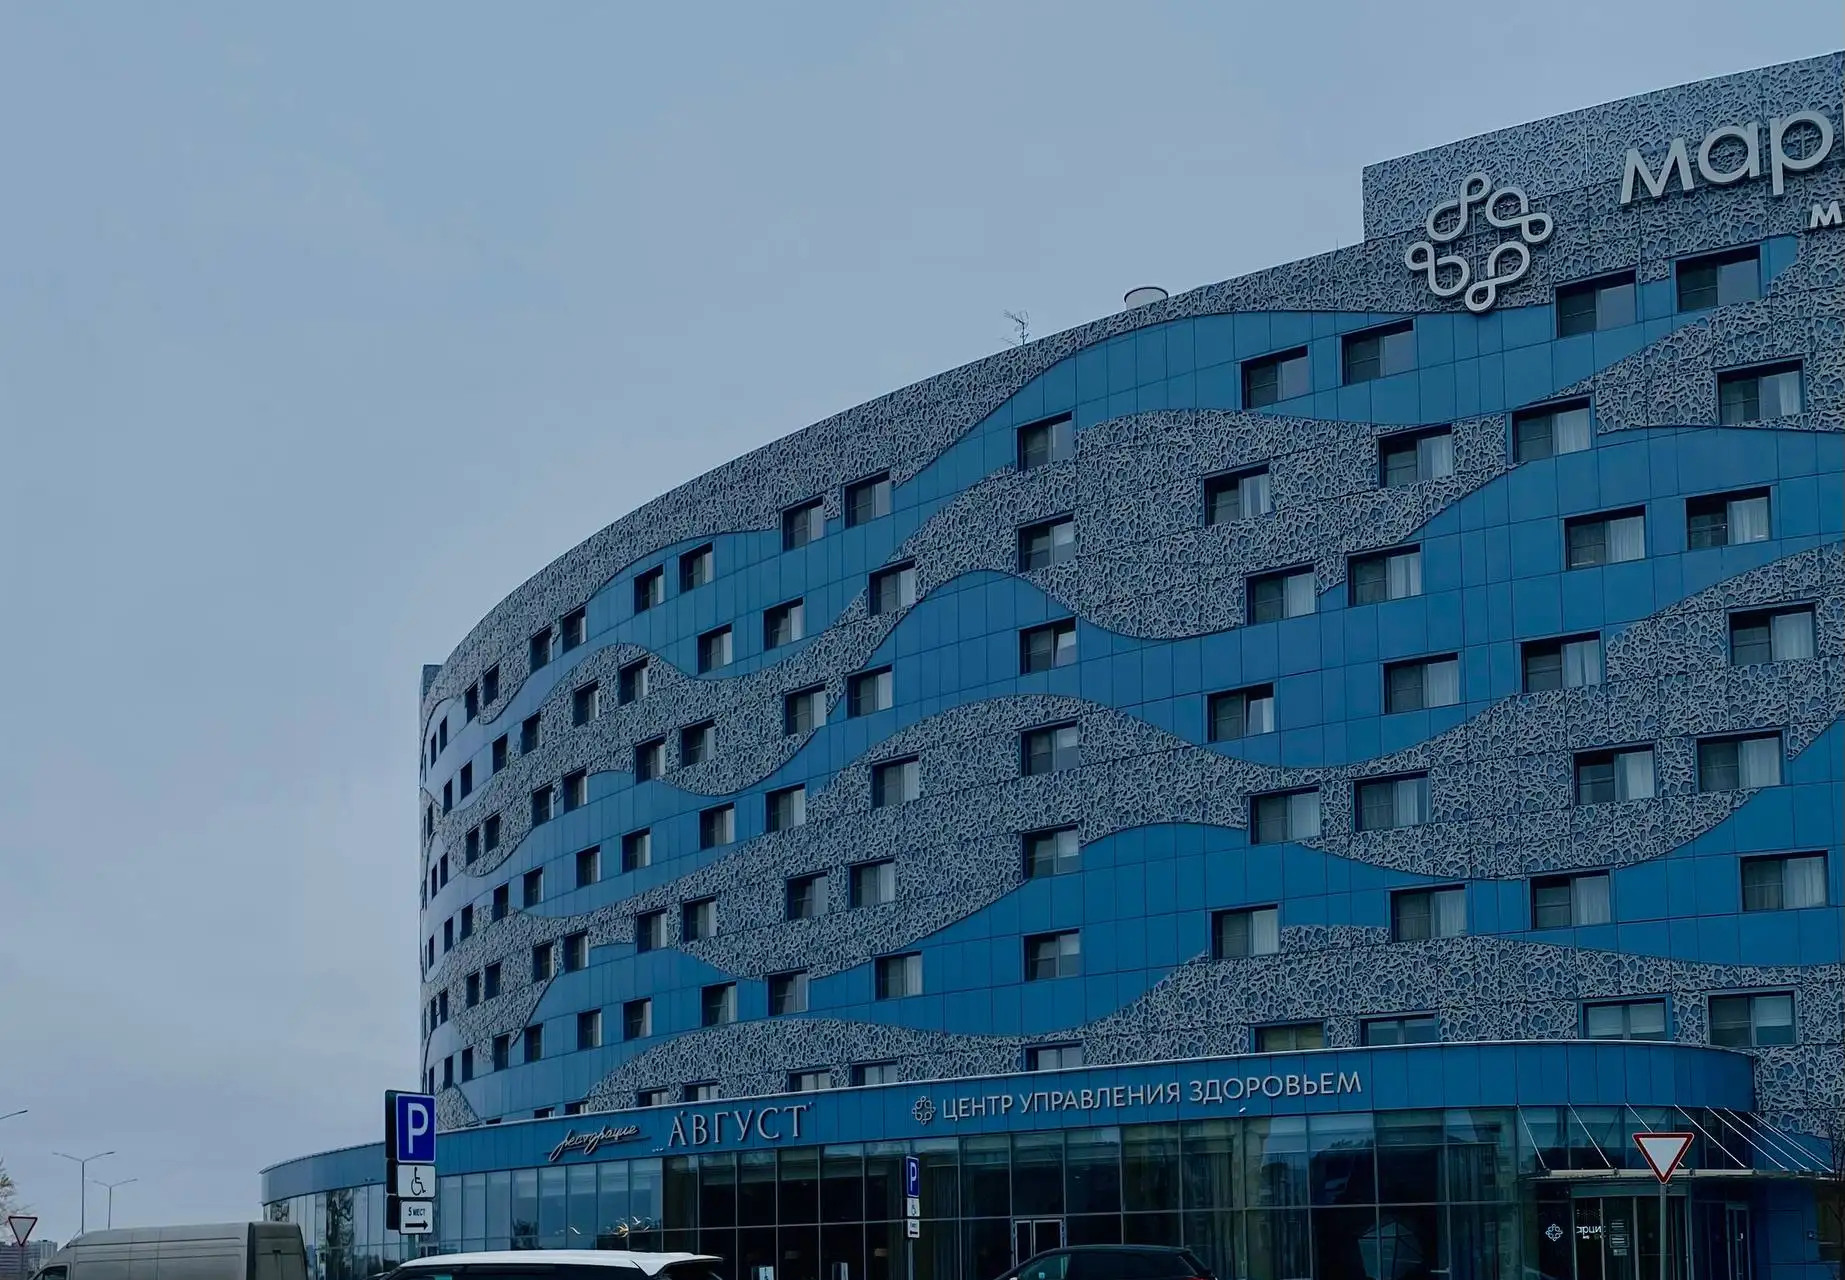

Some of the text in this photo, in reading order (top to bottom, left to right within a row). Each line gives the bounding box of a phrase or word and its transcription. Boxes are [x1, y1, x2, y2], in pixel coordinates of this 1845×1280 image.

[943, 1071, 1362, 1122] ЦЕНТР УПРАВЛЕНИЯ ЗДОРОВЬЕМ
